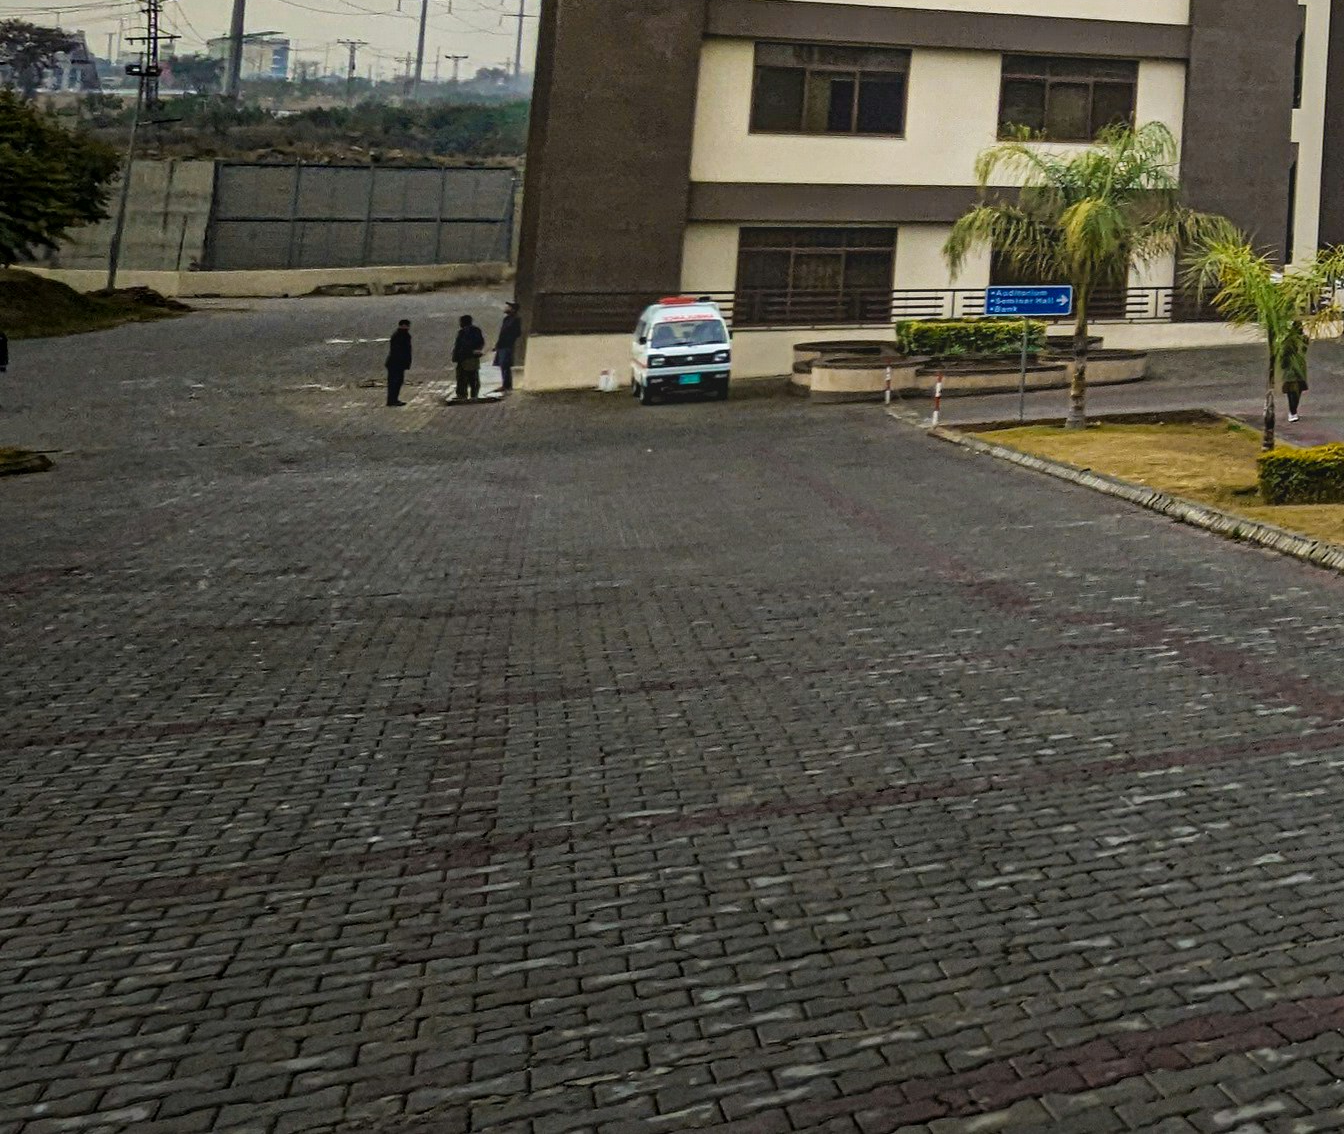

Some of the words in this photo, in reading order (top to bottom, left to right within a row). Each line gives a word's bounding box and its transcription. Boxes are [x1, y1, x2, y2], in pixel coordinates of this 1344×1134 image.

[996, 289, 1048, 297] Auditorium
[995, 297, 1033, 305] Seminar
[994, 305, 1018, 313] Bank
